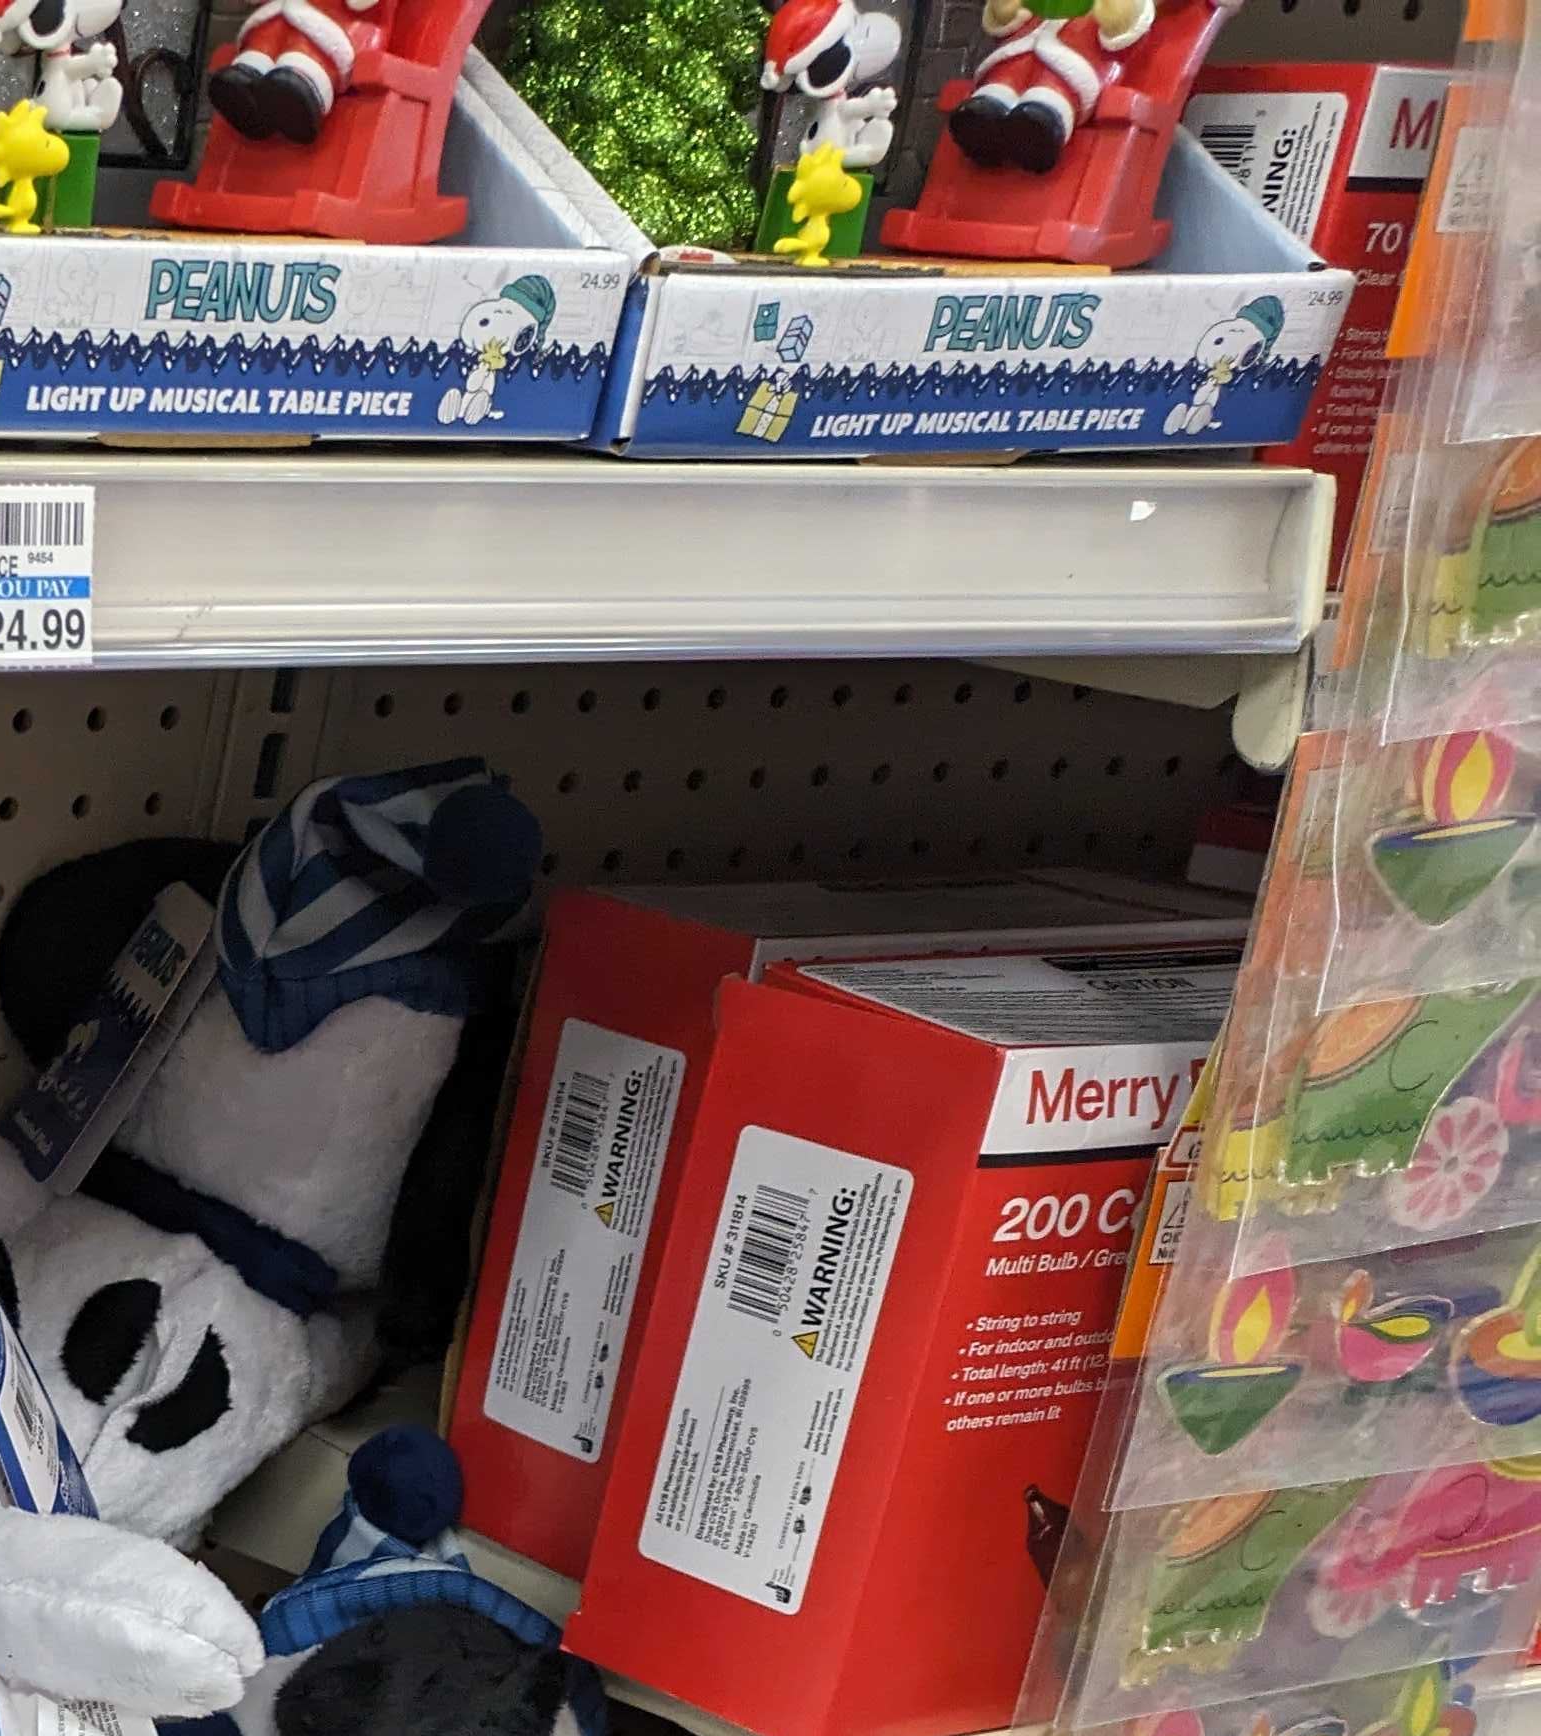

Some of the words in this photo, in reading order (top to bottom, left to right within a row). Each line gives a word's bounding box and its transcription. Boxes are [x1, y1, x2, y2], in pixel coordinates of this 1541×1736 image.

[1365, 223, 1403, 254] 70
[144, 258, 343, 325] PEANUTS
[923, 293, 1102, 353] PEANUTS
[26, 385, 106, 412] LIGHT
[109, 386, 147, 412] UP
[148, 387, 265, 416] MUSICAL
[267, 389, 347, 416] TABLE
[347, 391, 413, 418] PIECE
[811, 412, 879, 438] LIGHT
[881, 412, 914, 436] UP
[914, 410, 1015, 434] MUSICAL
[1016, 409, 1085, 432] TABLE
[1085, 407, 1145, 431] PIECE
[35, 578, 73, 598] PAY
[1026, 1067, 1179, 1130] Merry
[601, 1069, 643, 1199] WARNING:
[727, 1194, 749, 1245] 311814
[992, 1193, 1090, 1243] 200
[723, 1247, 734, 1262] #
[801, 1187, 858, 1328] WARNING:
[984, 1254, 1035, 1277] Multi
[1037, 1251, 1077, 1273] Bulb
[713, 1262, 733, 1290] SKU
[976, 1313, 1021, 1334] String
[1024, 1313, 1038, 1329] to
[1040, 1309, 1081, 1330] string
[968, 1341, 992, 1358] For
[995, 1335, 1044, 1355] indoor
[1045, 1332, 1072, 1350] and
[962, 1364, 995, 1383] Total
[1069, 1355, 1082, 1372] ft
[946, 1414, 993, 1432] others
[994, 1409, 1044, 1426] remain
